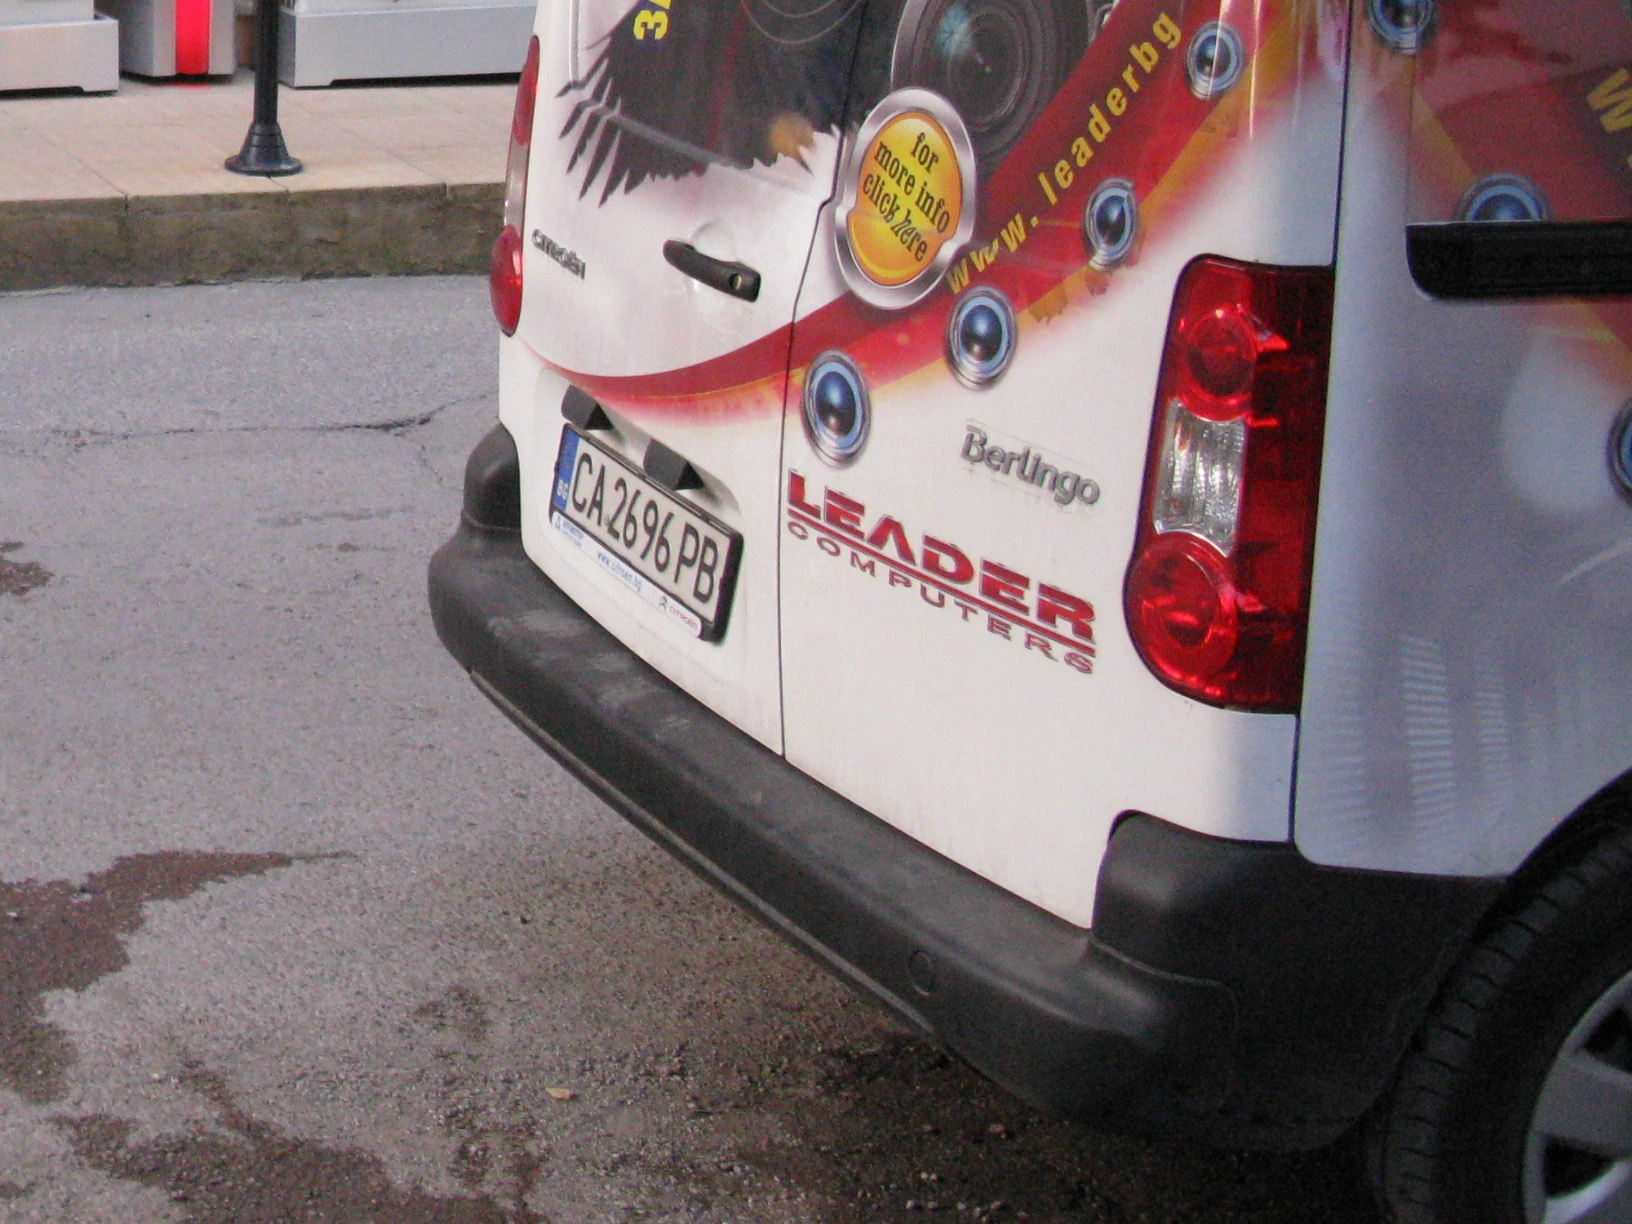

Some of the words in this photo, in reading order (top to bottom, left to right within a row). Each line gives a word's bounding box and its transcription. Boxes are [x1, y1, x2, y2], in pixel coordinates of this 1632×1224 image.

[873, 141, 916, 195] more
[914, 181, 950, 234] info
[910, 132, 939, 173] for
[862, 173, 900, 223] click
[890, 208, 928, 262] here
[961, 425, 1100, 505] Berlingo
[787, 521, 1094, 674] COMPUTERS
[788, 467, 1097, 645] LEADER
